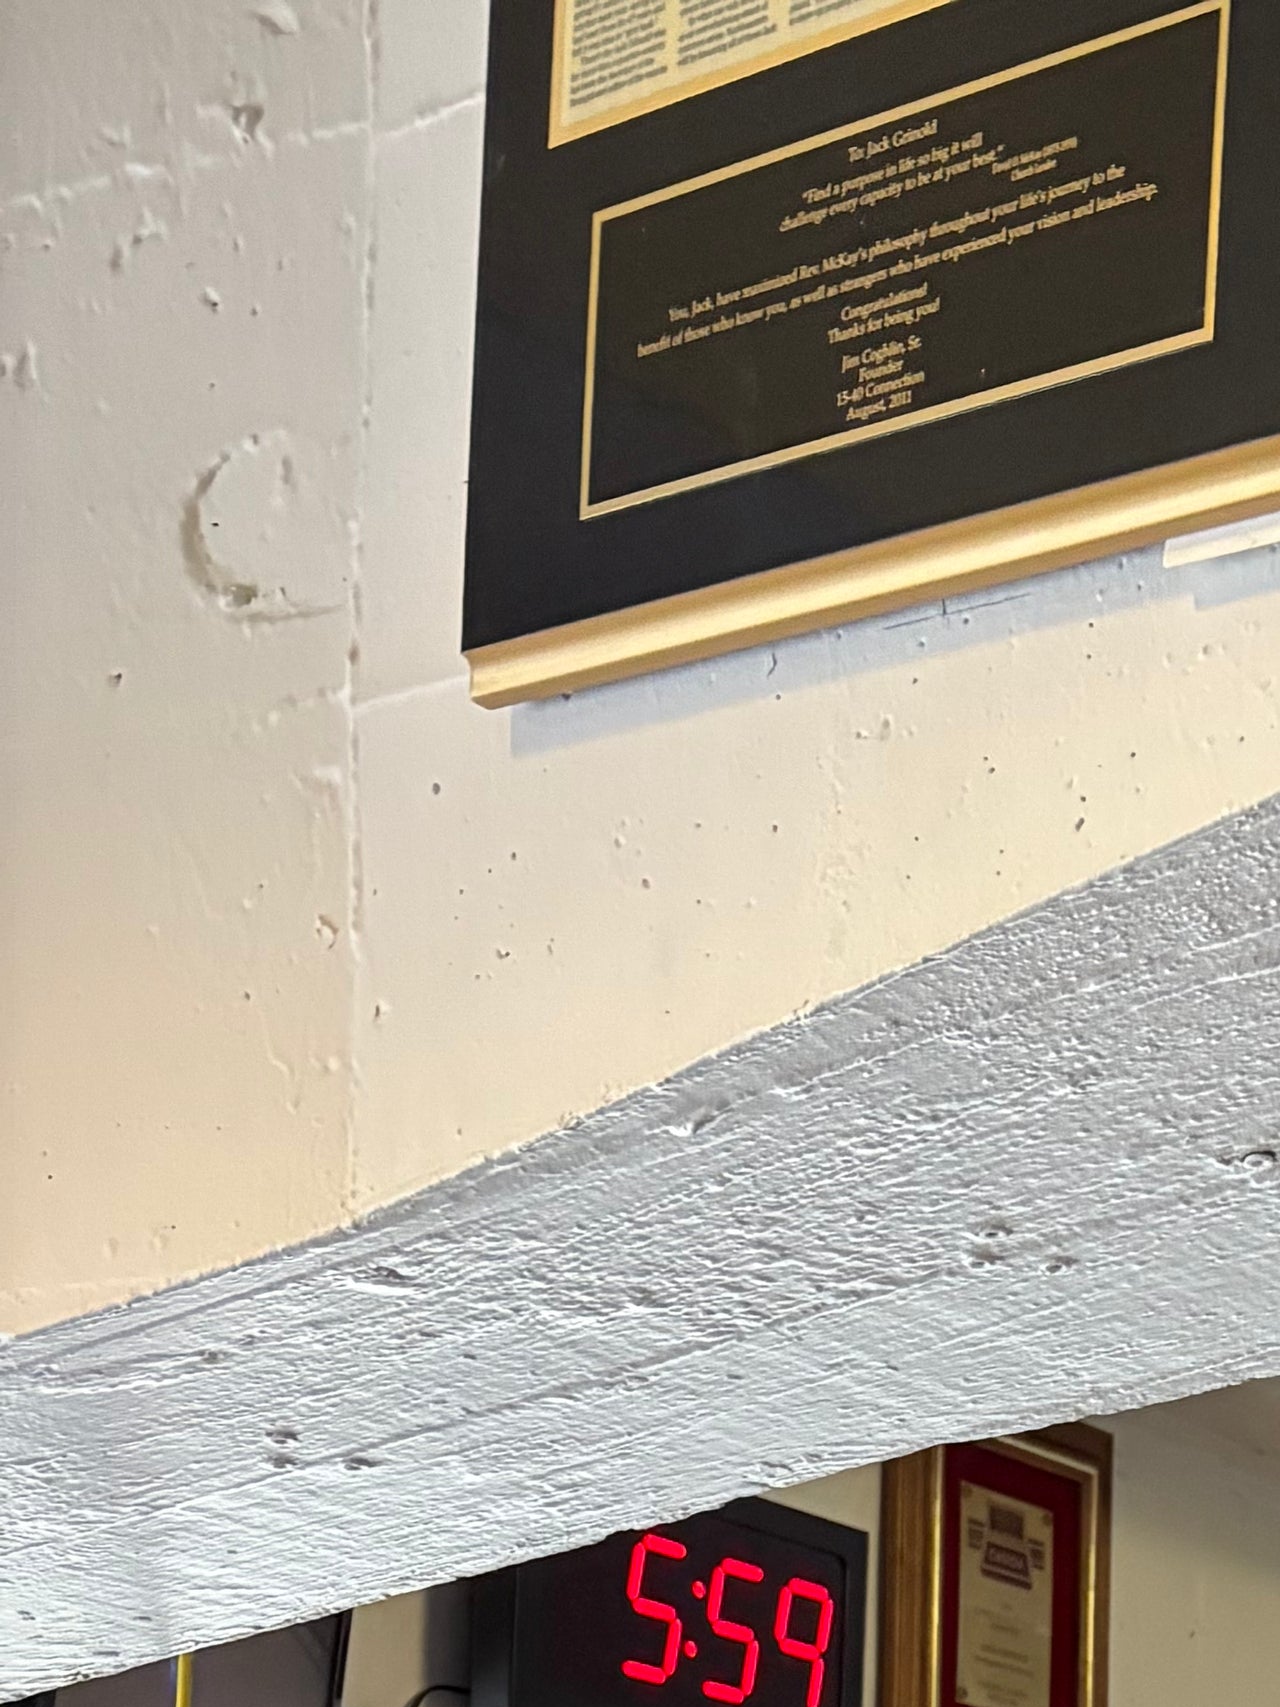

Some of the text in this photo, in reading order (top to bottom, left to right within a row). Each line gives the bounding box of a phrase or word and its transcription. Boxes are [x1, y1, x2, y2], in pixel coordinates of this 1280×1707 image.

[865, 135, 891, 160] Jack
[891, 118, 938, 148] Grinold
[840, 169, 885, 198] purpose
[884, 163, 898, 178] in
[898, 156, 917, 174] life
[916, 153, 931, 167] so
[930, 146, 950, 164] big
[950, 141, 960, 156] it
[961, 131, 983, 152] will
[779, 207, 830, 232] challenge
[828, 197, 859, 216] every
[859, 182, 904, 207] capacity
[904, 178, 917, 191] to
[917, 171, 932, 187] be
[931, 166, 944, 182] at
[944, 159, 972, 182] your
[716, 290, 742, 307] have
[868, 228, 928, 263] philosophy
[928, 207, 991, 238] throughout
[990, 199, 1020, 223] your
[1046, 176, 1091, 205] journey
[1091, 172, 1106, 186] to
[1106, 163, 1126, 181] the
[637, 335, 671, 358] benefit
[671, 330, 684, 347] of
[683, 325, 711, 343] those
[711, 315, 735, 333] who
[735, 308, 765, 326] know
[788, 296, 802, 309] as
[802, 284, 826, 304] well
[825, 284, 839, 298] as
[839, 268, 888, 294] strangers
[888, 259, 913, 277] who
[913, 252, 941, 270] have
[941, 226, 1007, 262] experienced
[1007, 221, 1035, 245] your
[1035, 210, 1071, 230] vision
[1070, 198, 1095, 220] and
[827, 317, 866, 344] Thanks
[866, 317, 884, 333] for
[883, 308, 915, 328] being
[841, 355, 861, 374] Jim
[858, 359, 905, 383] Founder
[864, 370, 925, 398] Connection
